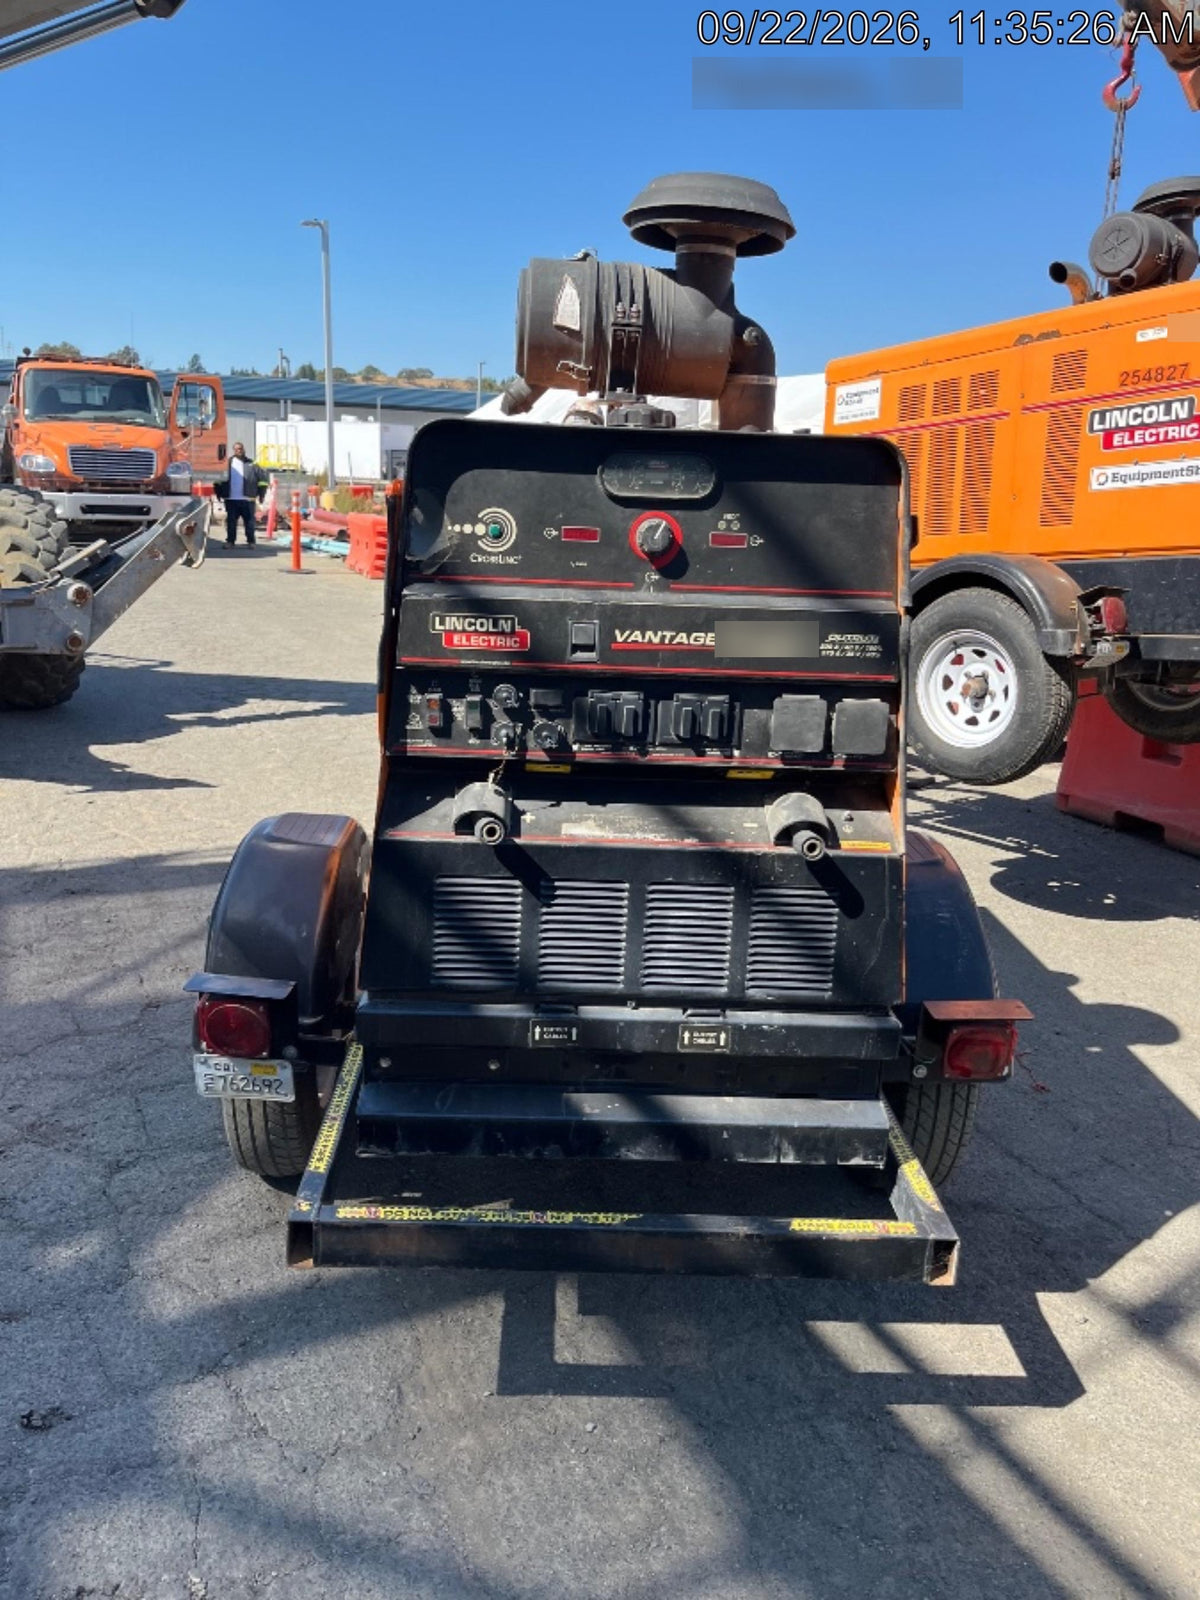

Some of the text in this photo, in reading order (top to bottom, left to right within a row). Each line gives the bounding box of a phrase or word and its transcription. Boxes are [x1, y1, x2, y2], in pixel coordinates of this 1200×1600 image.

[1119, 362, 1190, 386] 254827
[1092, 400, 1189, 432] LINCOLN
[1112, 422, 1199, 447] ELECTRIC
[434, 616, 511, 632] LINCOLN
[452, 634, 520, 648] ELECTRIC
[614, 629, 715, 646] VANTAGE
